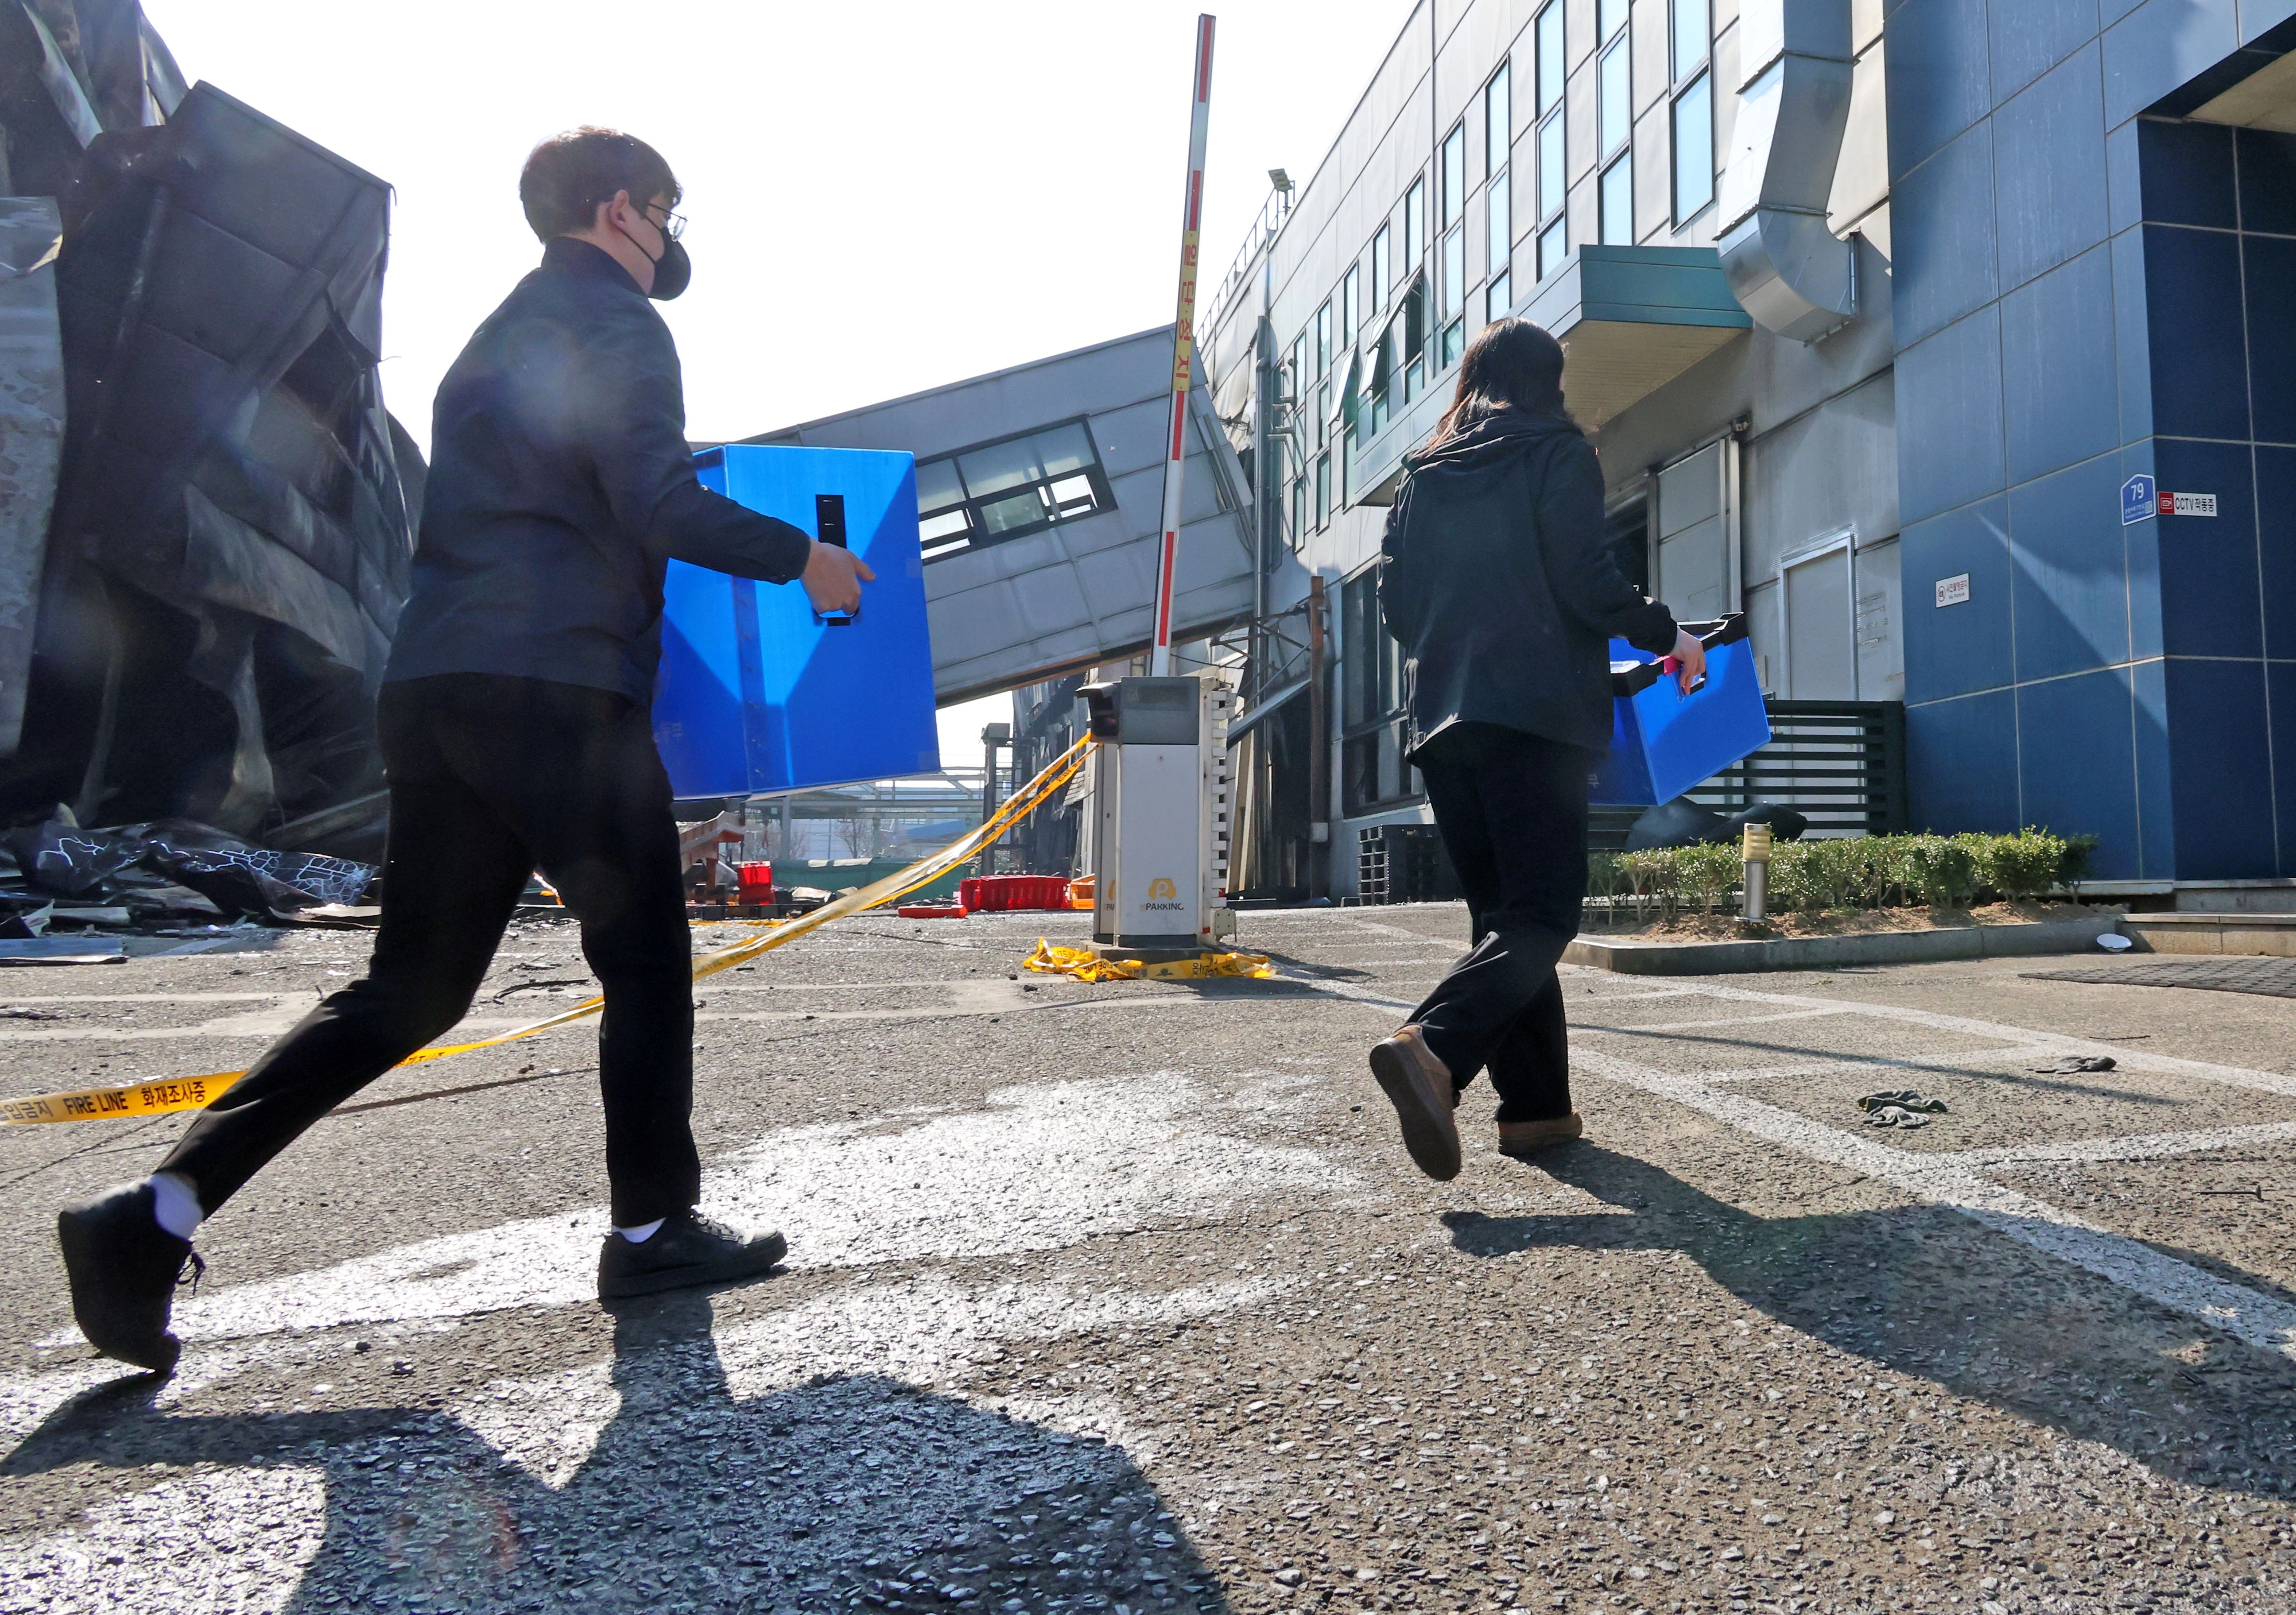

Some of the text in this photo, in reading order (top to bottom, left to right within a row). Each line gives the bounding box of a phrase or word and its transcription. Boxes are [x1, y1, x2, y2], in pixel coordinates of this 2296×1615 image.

[2131, 482, 2144, 501] 79
[63, 1095, 97, 1115] FIRE
[96, 1091, 129, 1113] LINE
[141, 1081, 206, 1109] 화재조사중
